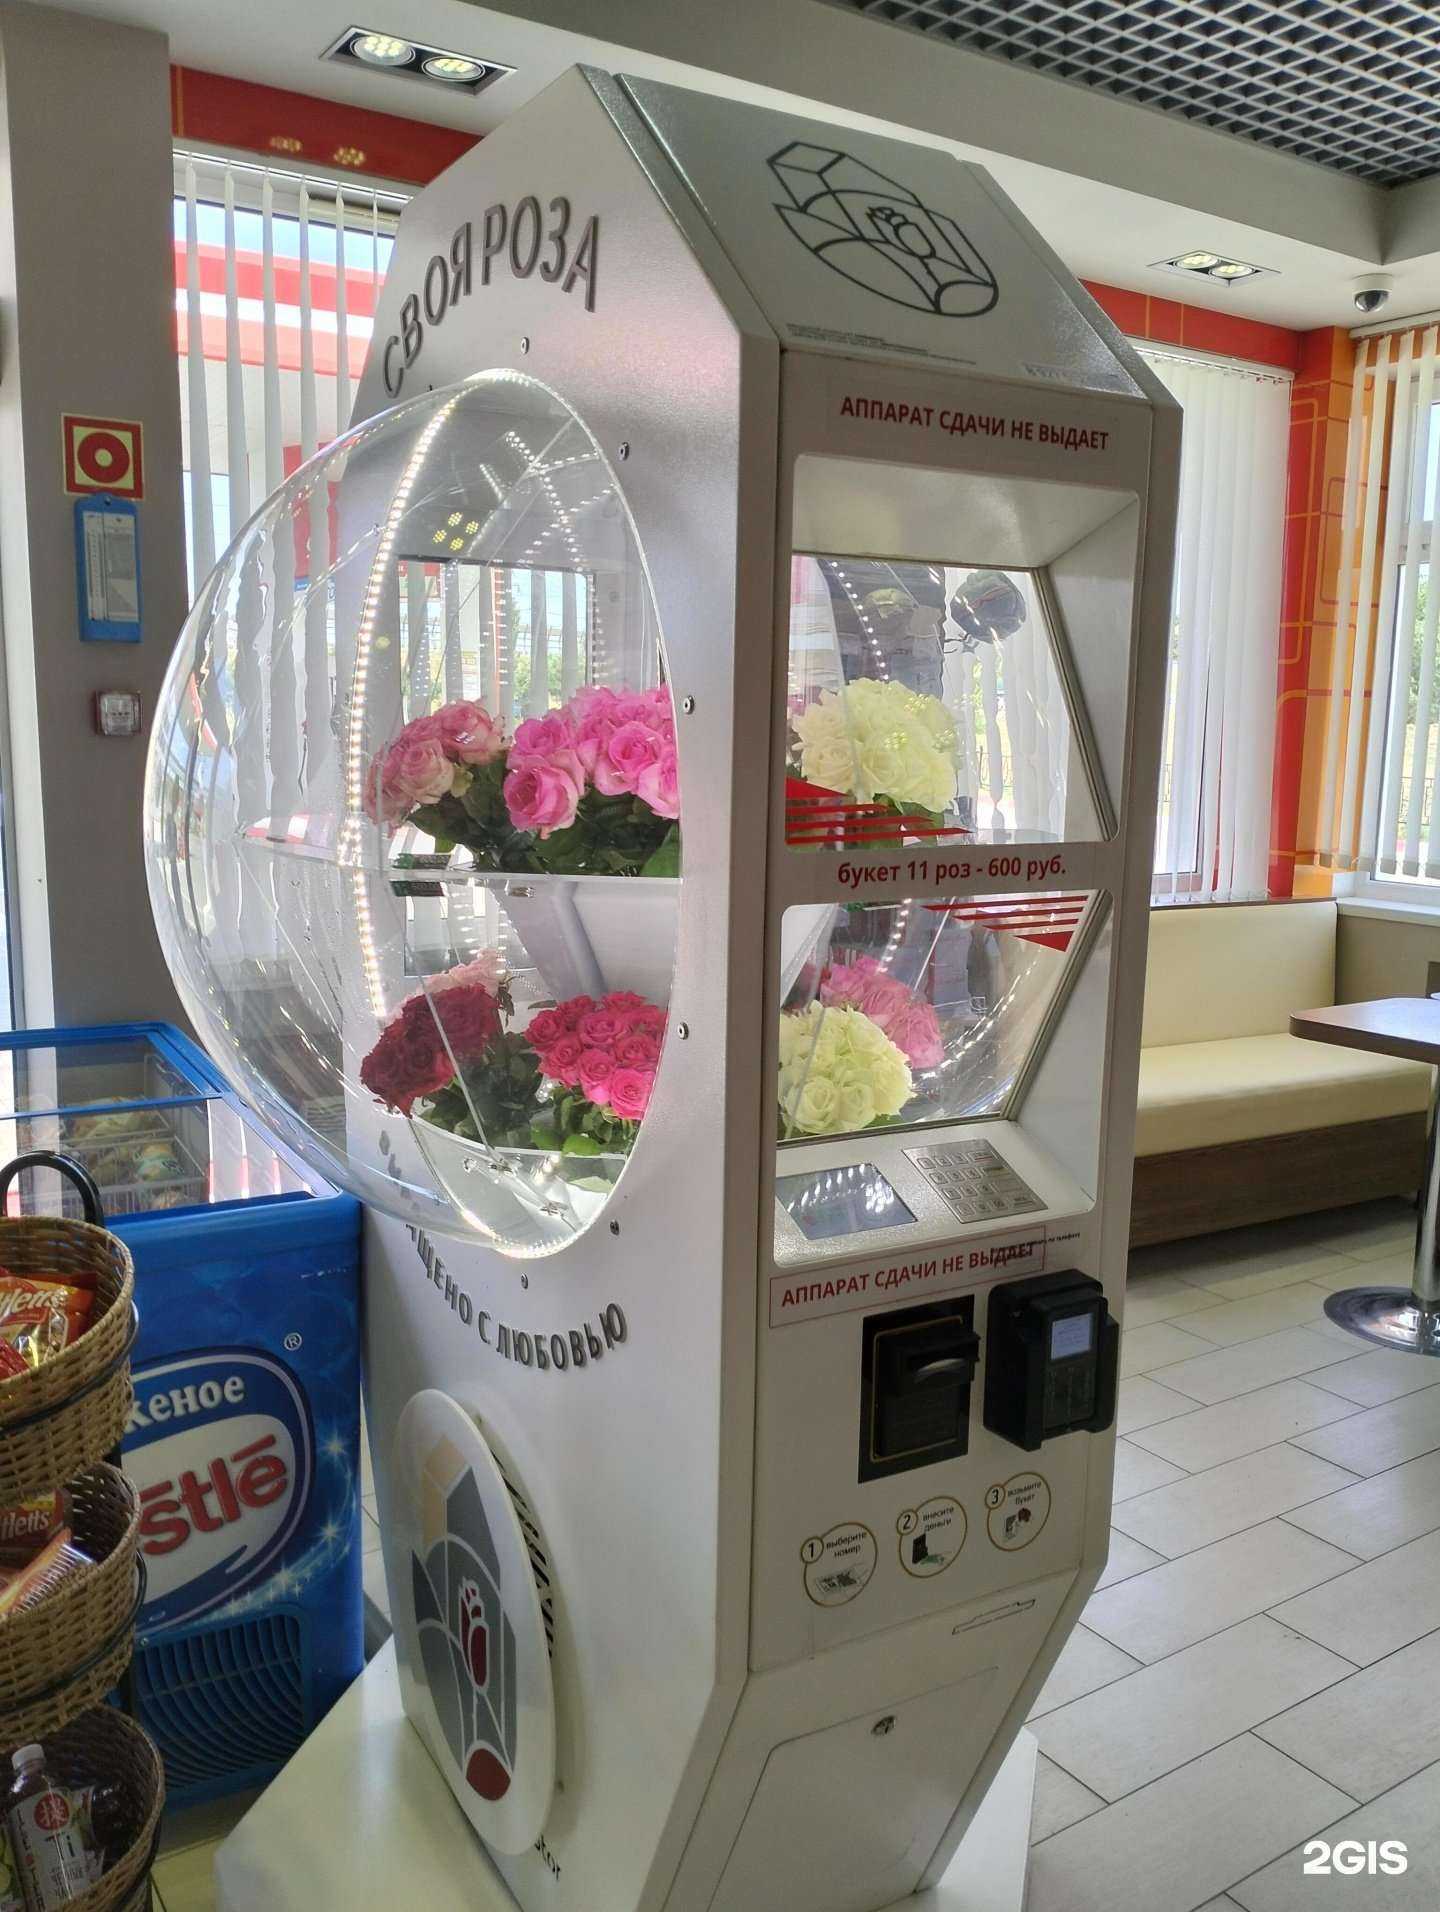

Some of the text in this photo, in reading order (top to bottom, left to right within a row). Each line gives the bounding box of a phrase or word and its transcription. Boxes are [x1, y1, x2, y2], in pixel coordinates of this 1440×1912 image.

[840, 396, 1109, 450] АППАРАТ СДАЧИ НЕ ВЫДАЕТ
[838, 862, 900, 888] букет
[907, 861, 928, 881] 11
[935, 862, 971, 885] роз
[988, 857, 1021, 877] 600
[1027, 855, 1066, 881] руб.
[781, 1273, 870, 1308] АППАРАТ
[874, 1262, 937, 1290] СДАЧИ
[942, 1255, 964, 1273] НЕ
[496, 1302, 628, 1370] ЛЮБОВЬЮ
[990, 1488, 999, 1505] 3
[902, 1514, 911, 1530] 2
[808, 1543, 816, 1558] 1
